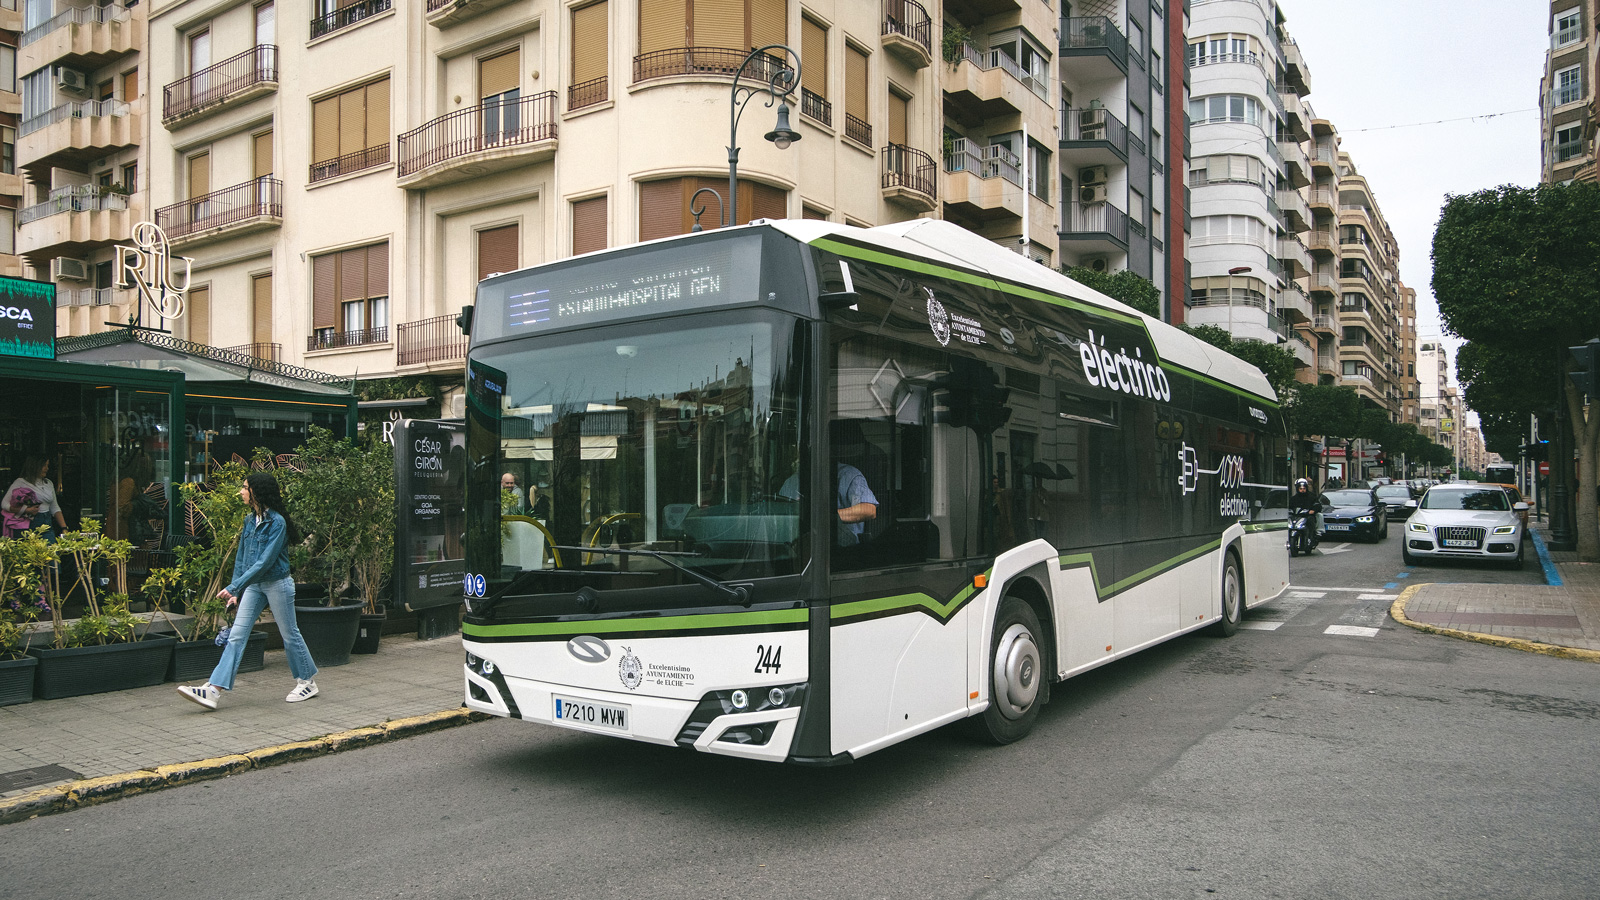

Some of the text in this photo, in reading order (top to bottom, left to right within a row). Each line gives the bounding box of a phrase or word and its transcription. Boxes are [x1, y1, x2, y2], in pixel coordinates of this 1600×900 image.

[113, 221, 195, 320] RIU
[951, 322, 986, 338] AYUNTAMIENTO
[1079, 328, 1171, 403] eléctrico
[414, 436, 442, 454] CÉSAR
[414, 455, 443, 471] GIRÓN
[1219, 454, 1245, 489] 100%
[1219, 492, 1248, 517] eléctrico
[754, 644, 782, 674] 244
[645, 670, 695, 680] AYUNTAMIENTO
[664, 679, 684, 687] ELCHE
[565, 702, 625, 727] 7210 MVW
